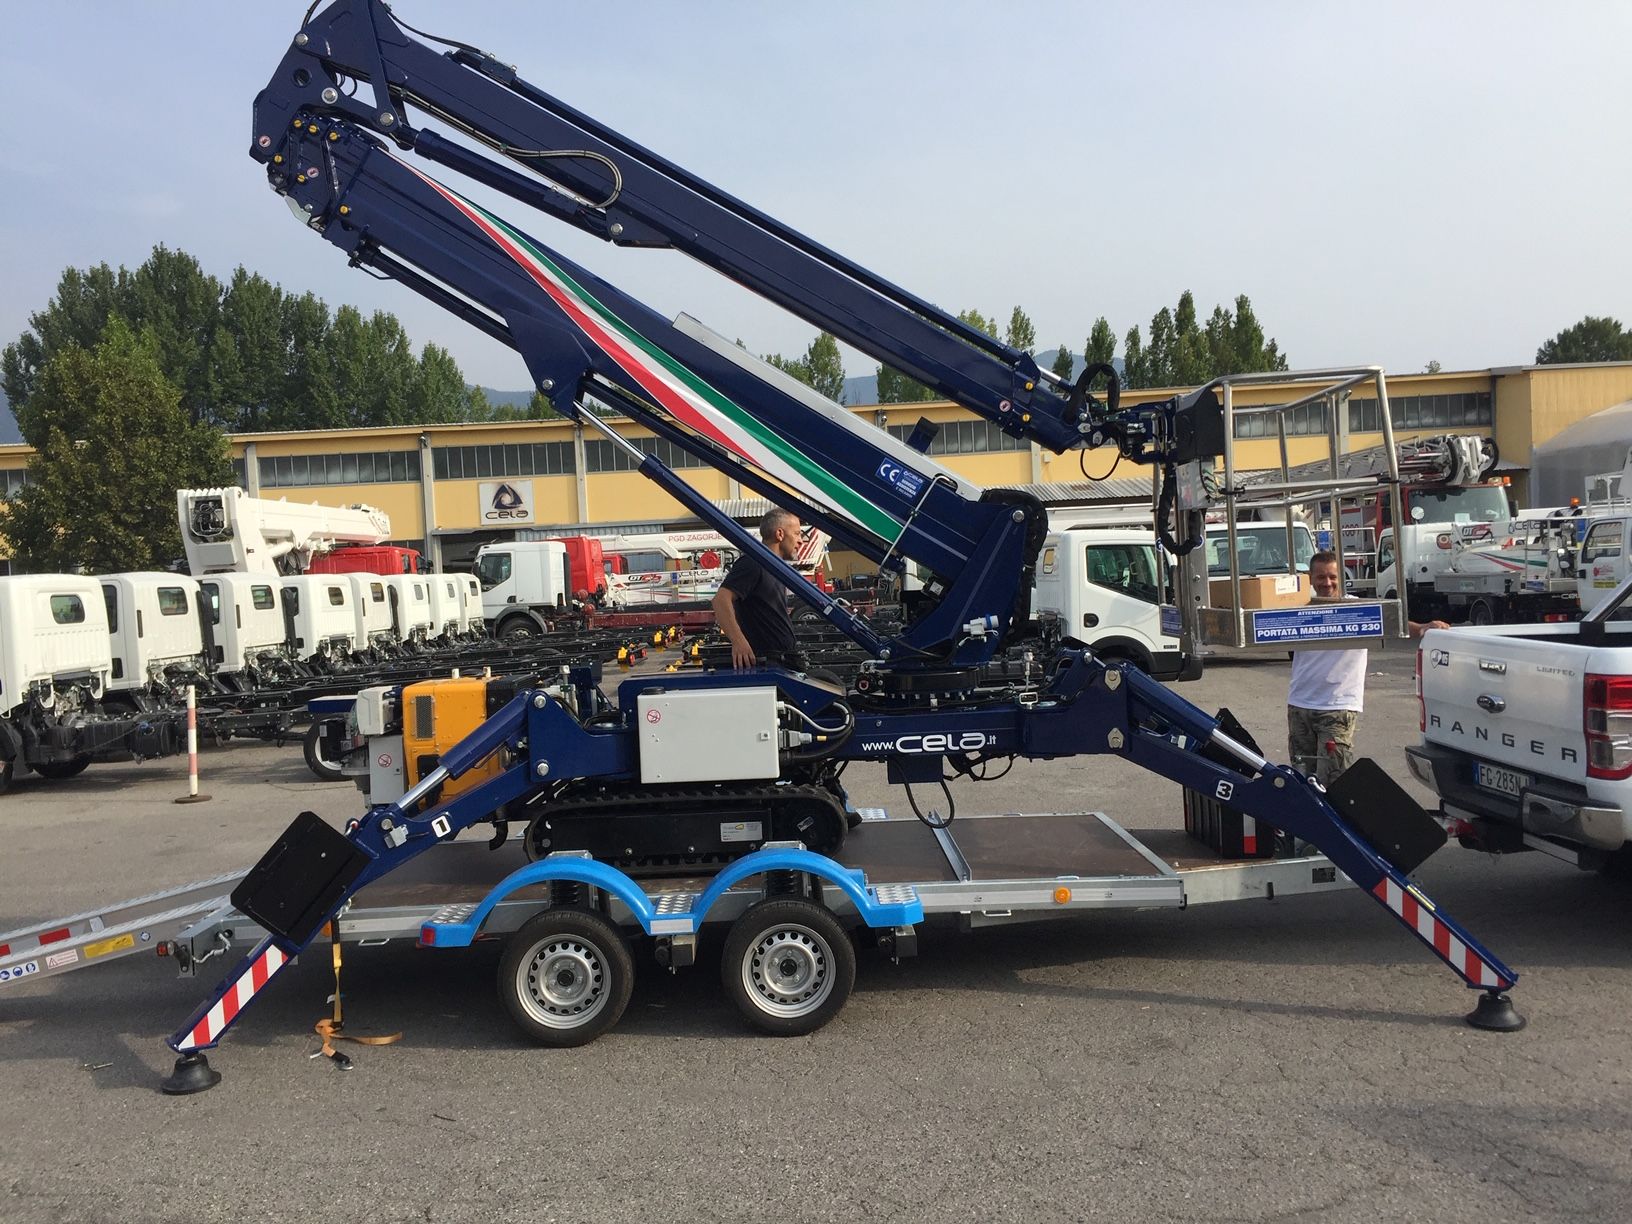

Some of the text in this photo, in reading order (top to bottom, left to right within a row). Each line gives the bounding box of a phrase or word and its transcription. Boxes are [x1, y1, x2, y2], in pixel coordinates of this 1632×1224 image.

[1257, 623, 1380, 637] PORTATA MASSIMA KG 230
[1430, 714, 1578, 763] RANGER
[1217, 783, 1231, 798] 3
[436, 819, 447, 832] 1
